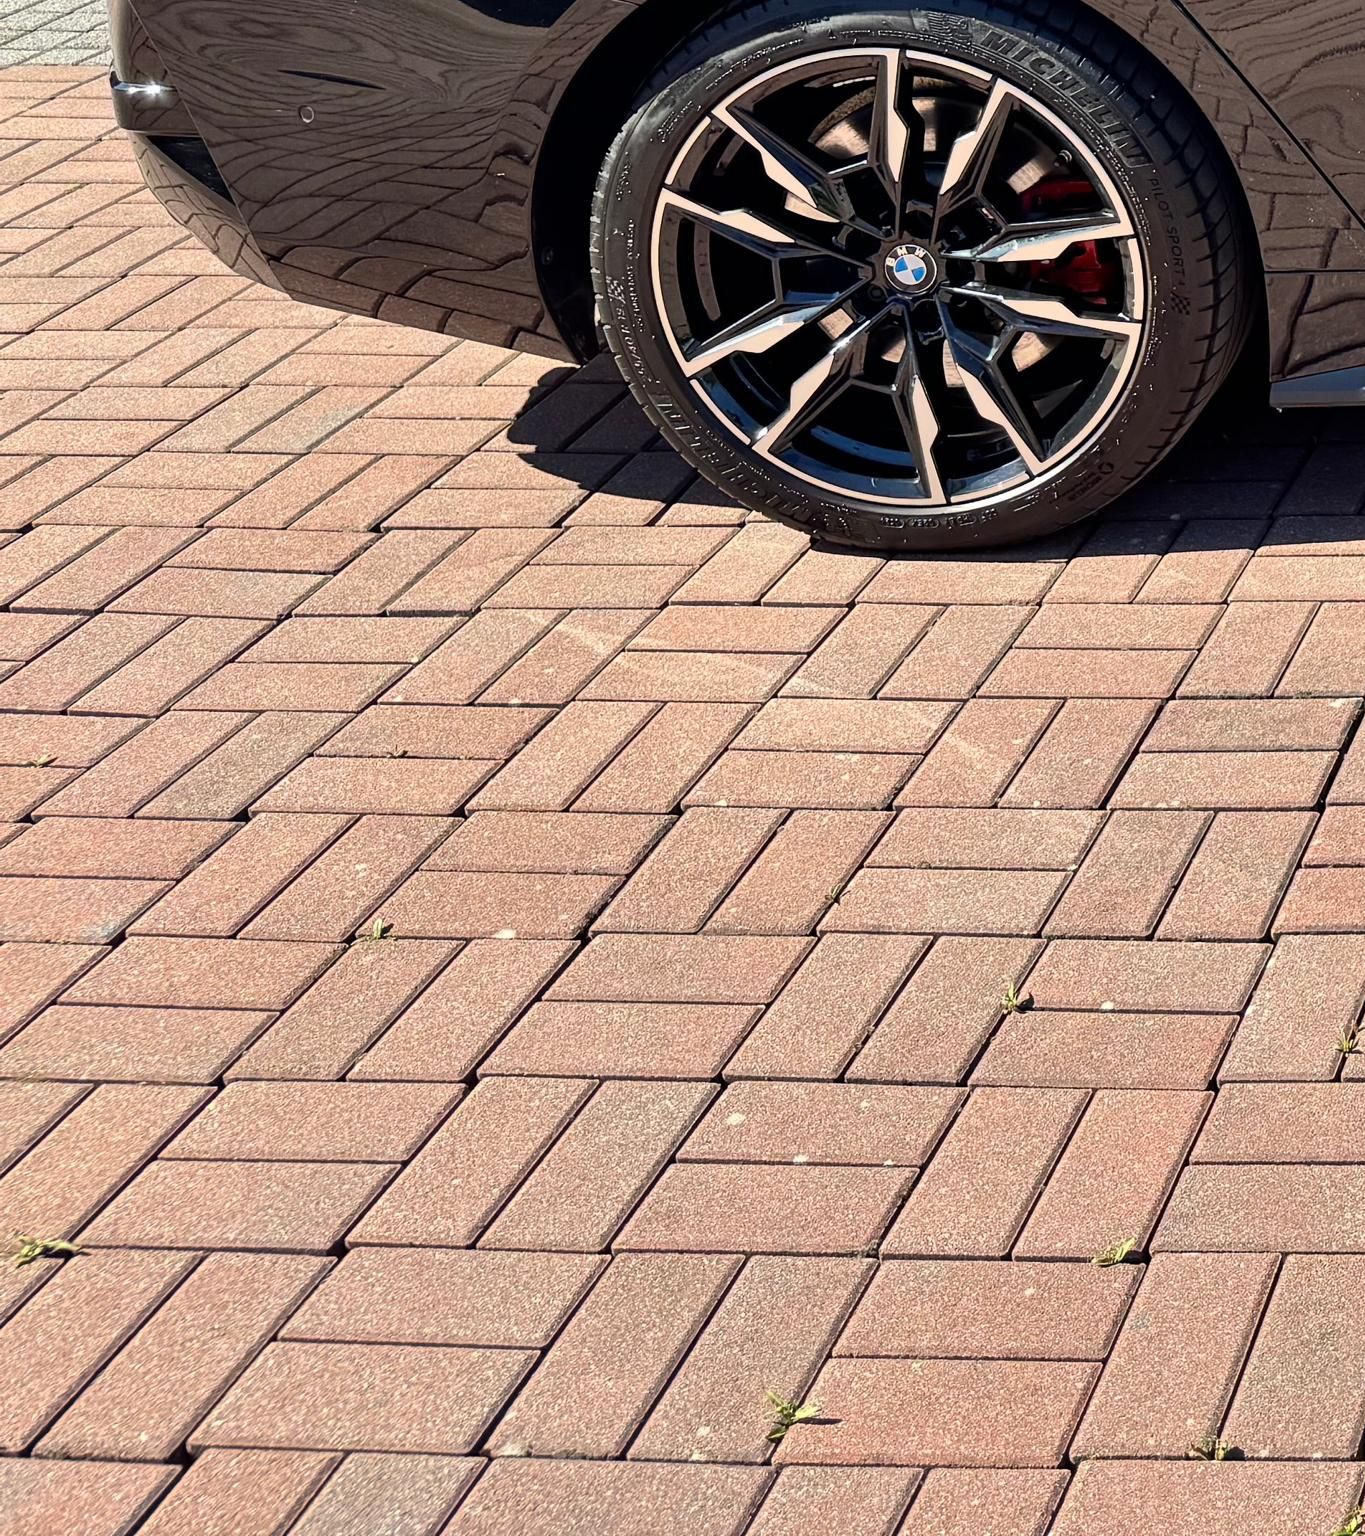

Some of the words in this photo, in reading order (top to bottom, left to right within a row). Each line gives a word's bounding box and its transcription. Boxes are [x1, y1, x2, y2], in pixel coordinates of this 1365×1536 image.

[980, 29, 1146, 164] MICHELIN
[1148, 177, 1174, 221] PILOT
[1167, 226, 1185, 276] SPORT
